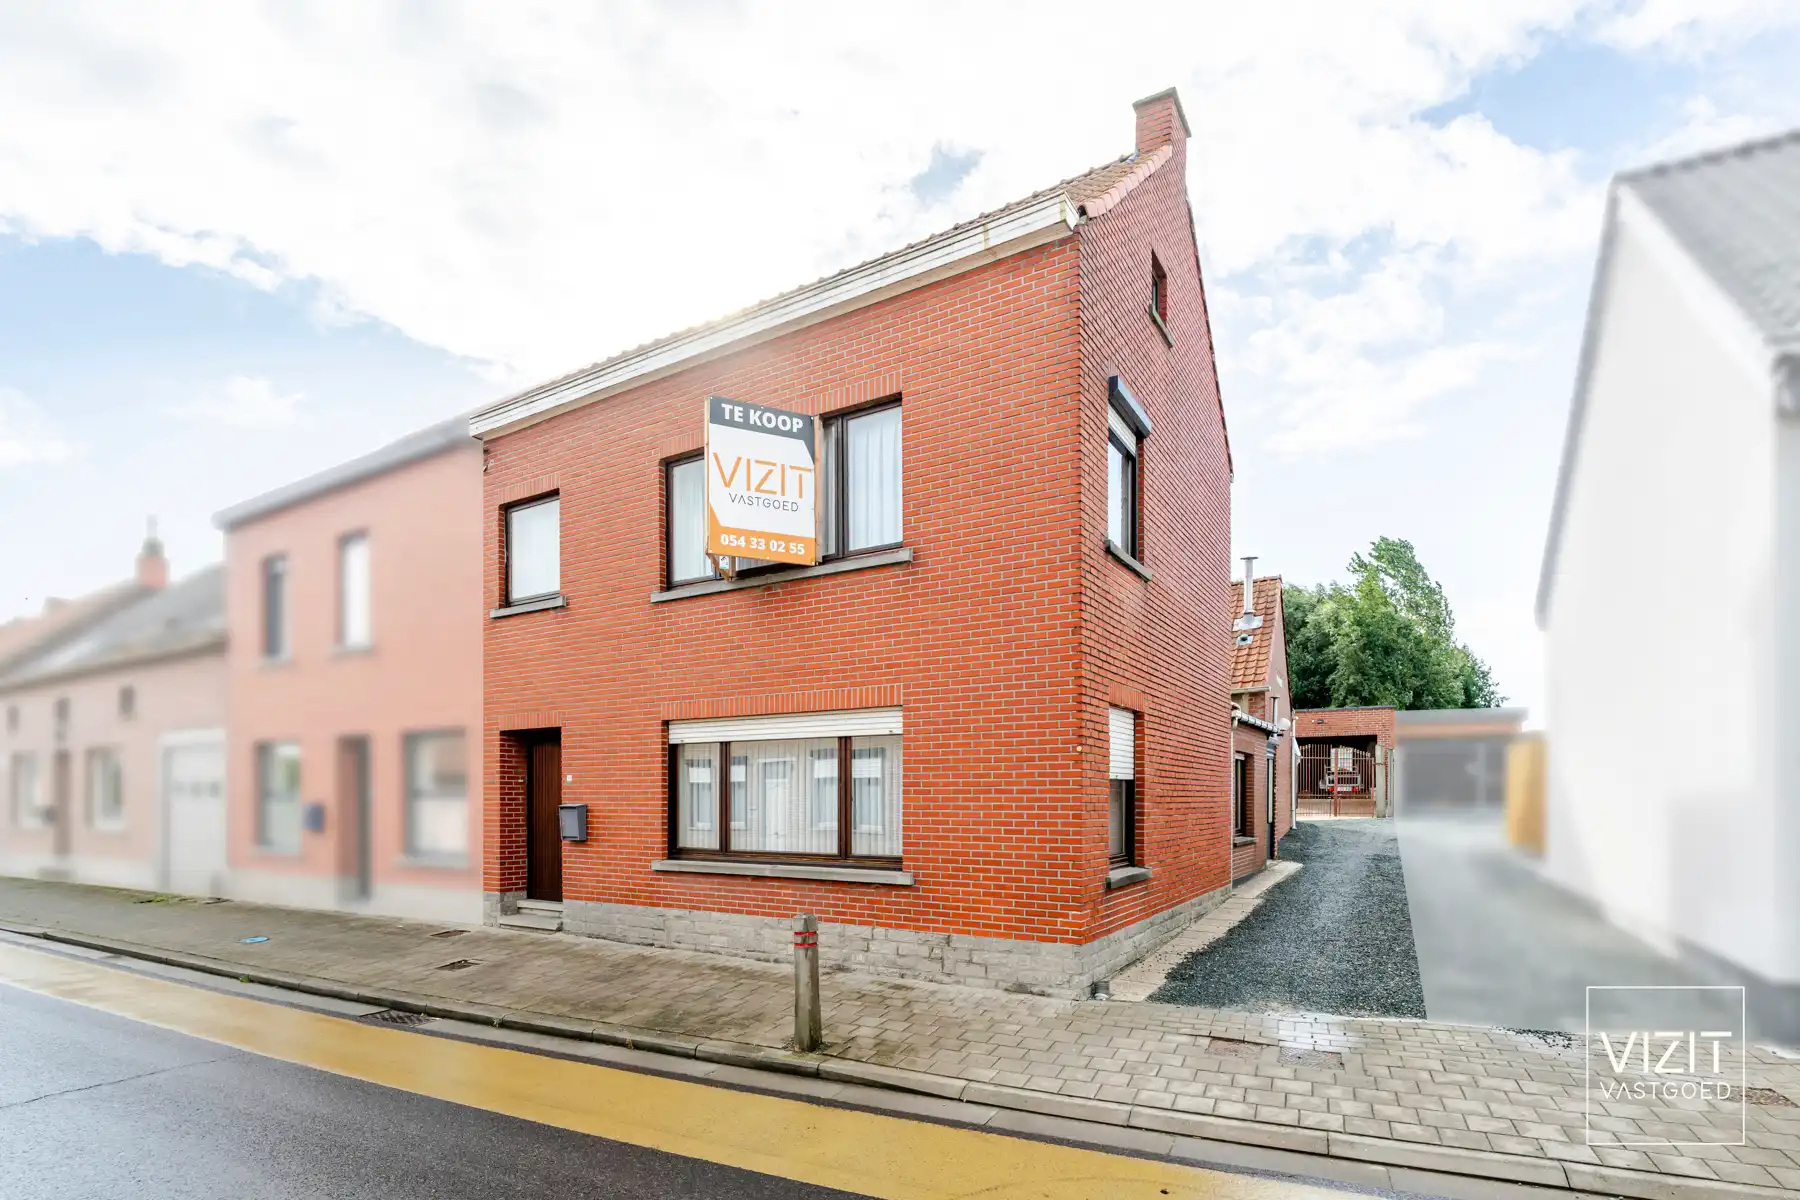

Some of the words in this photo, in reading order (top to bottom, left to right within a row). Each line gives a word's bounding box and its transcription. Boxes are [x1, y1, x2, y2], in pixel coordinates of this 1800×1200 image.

[721, 403, 744, 423] TE
[750, 409, 804, 433] KOOP
[713, 452, 812, 499] VIZIT
[728, 492, 799, 512] VASTGOED
[720, 533, 746, 548] 054
[749, 537, 767, 551] 33
[769, 540, 786, 553] 02
[789, 543, 805, 555] 55
